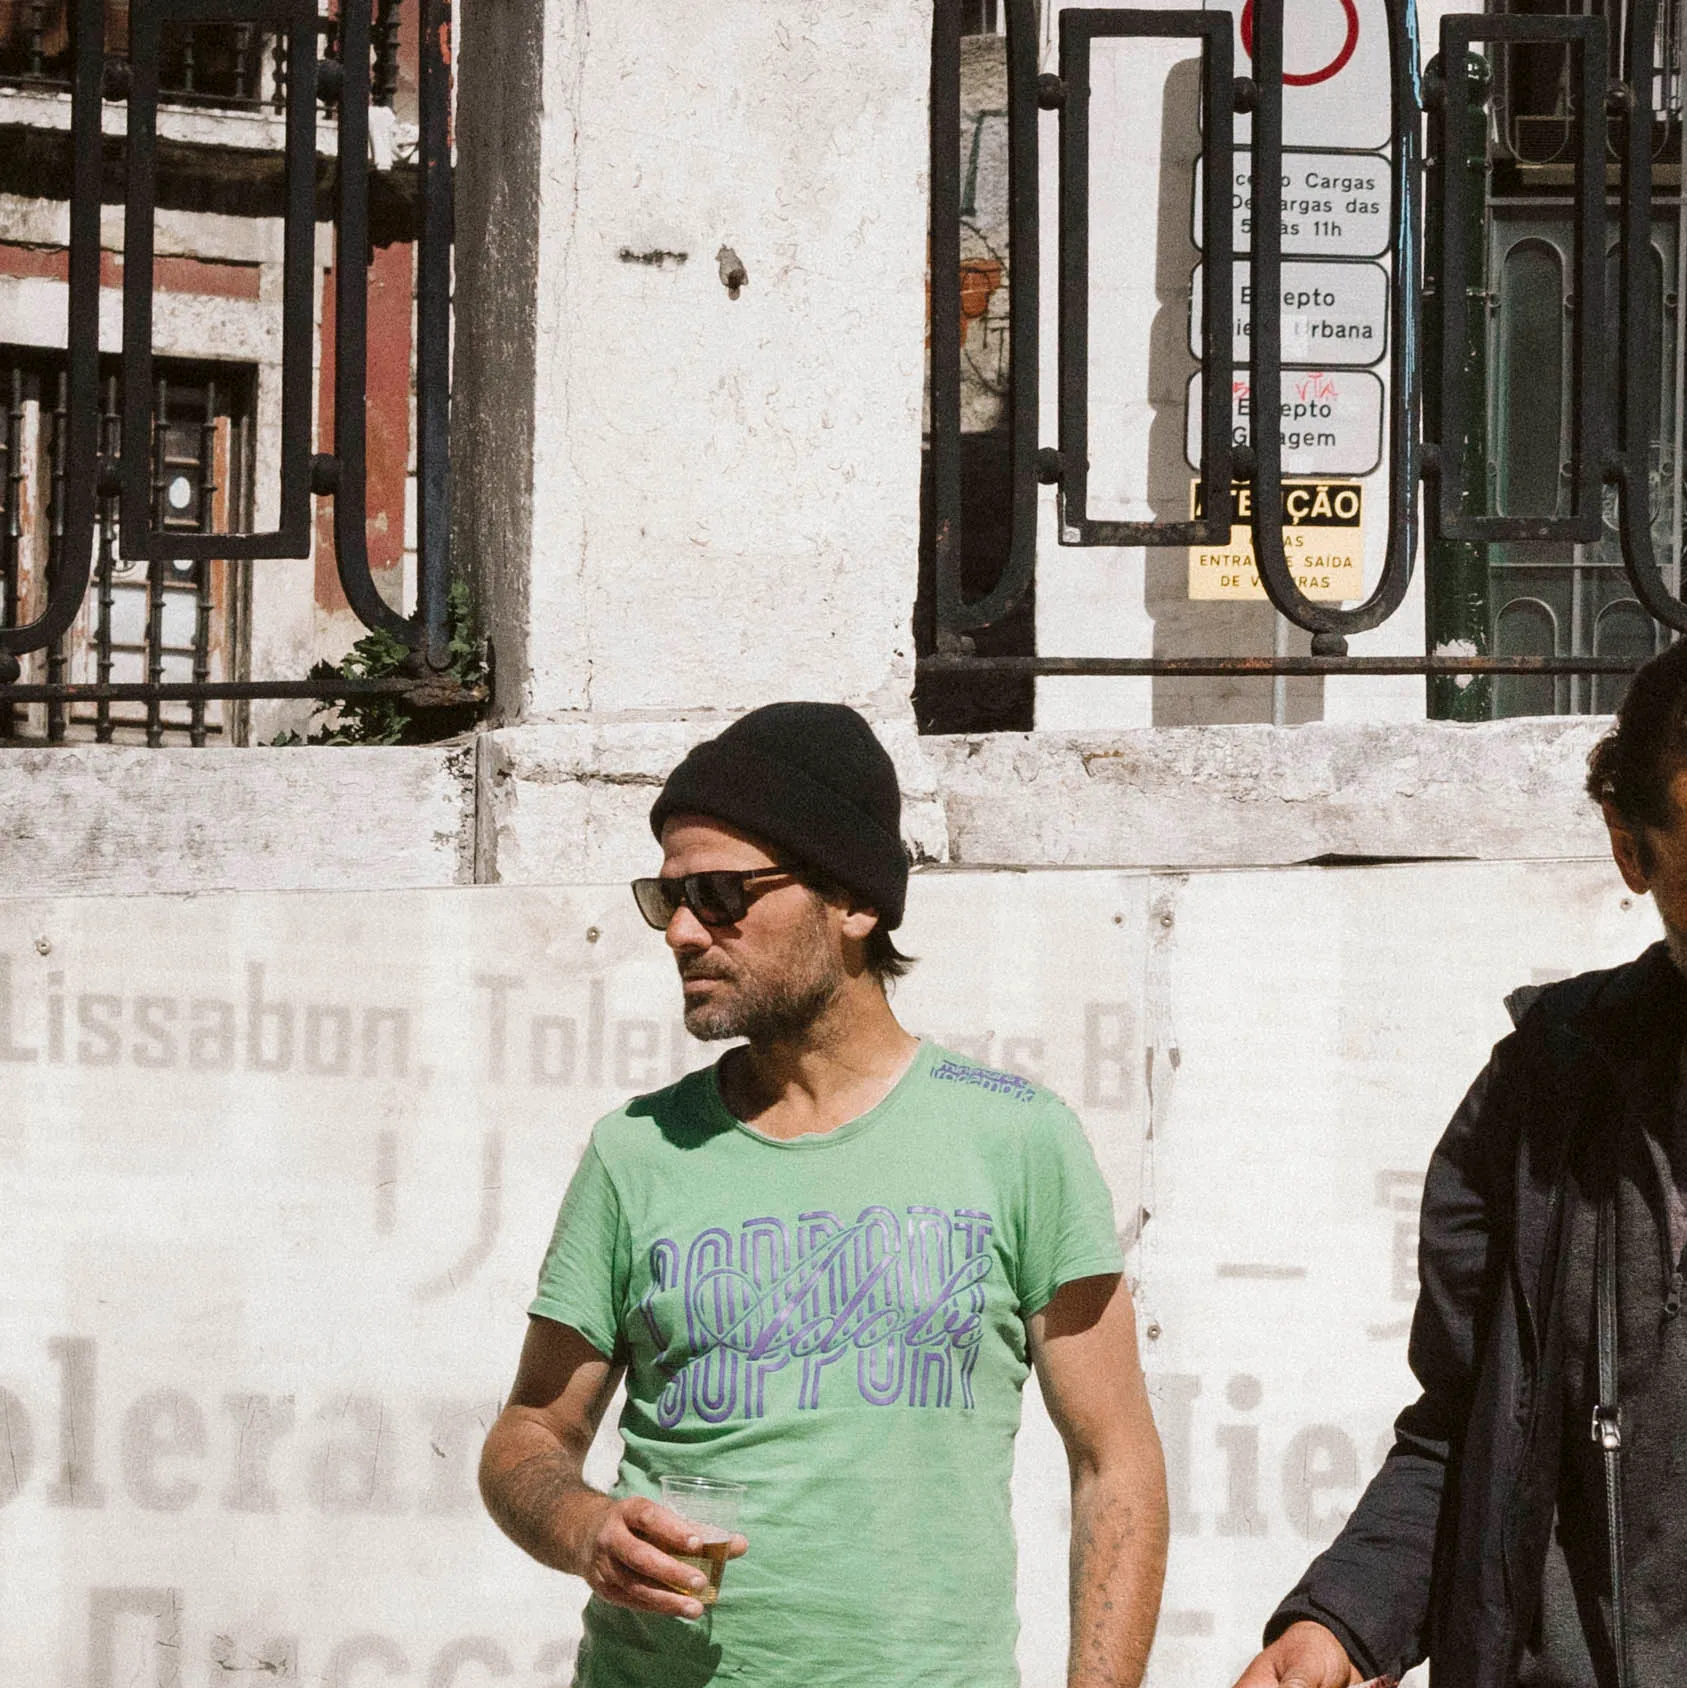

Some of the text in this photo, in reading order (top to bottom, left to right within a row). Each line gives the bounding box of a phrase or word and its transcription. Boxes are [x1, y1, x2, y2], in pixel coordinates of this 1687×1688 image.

[1305, 172, 1375, 192] Cargas
[1233, 194, 1380, 214] Deargas das
[1313, 221, 1342, 236] 11h
[1241, 286, 1336, 309] Eepto
[1239, 399, 1332, 420] Eepto
[1304, 555, 1353, 569] SAÍDA
[1220, 575, 1240, 587] DE
